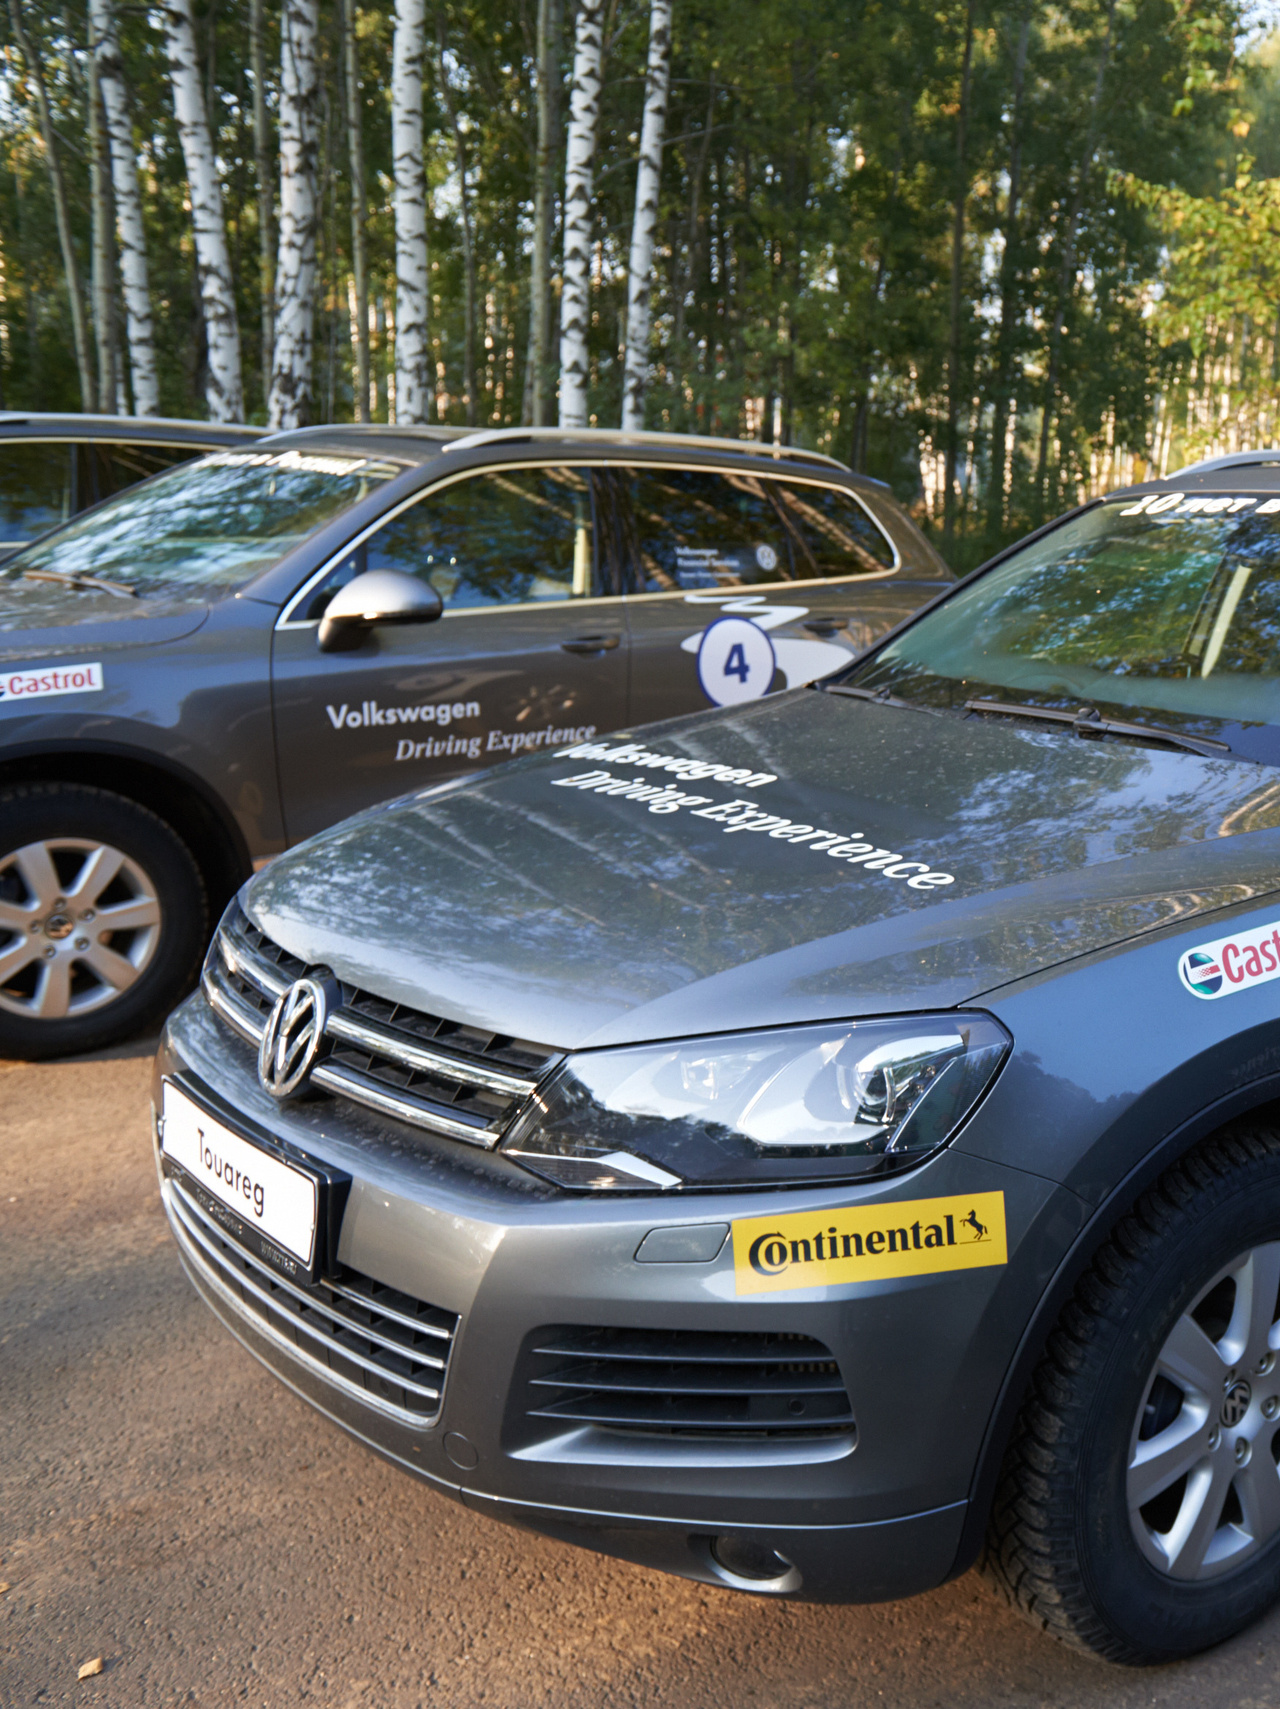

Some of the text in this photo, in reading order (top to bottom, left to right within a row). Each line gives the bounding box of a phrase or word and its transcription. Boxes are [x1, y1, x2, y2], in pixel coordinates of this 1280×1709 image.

[1120, 493, 1185, 516] 10
[1176, 497, 1258, 514] лет
[8, 667, 96, 697] Castrol
[723, 643, 750, 683] 4
[326, 700, 480, 729] Volkswagen
[395, 725, 597, 762] Driving Experience
[552, 742, 778, 788] Volkswagen
[551, 770, 955, 890] Driving Experience
[197, 1127, 265, 1218] Touareg
[748, 1214, 958, 1277] Continental
